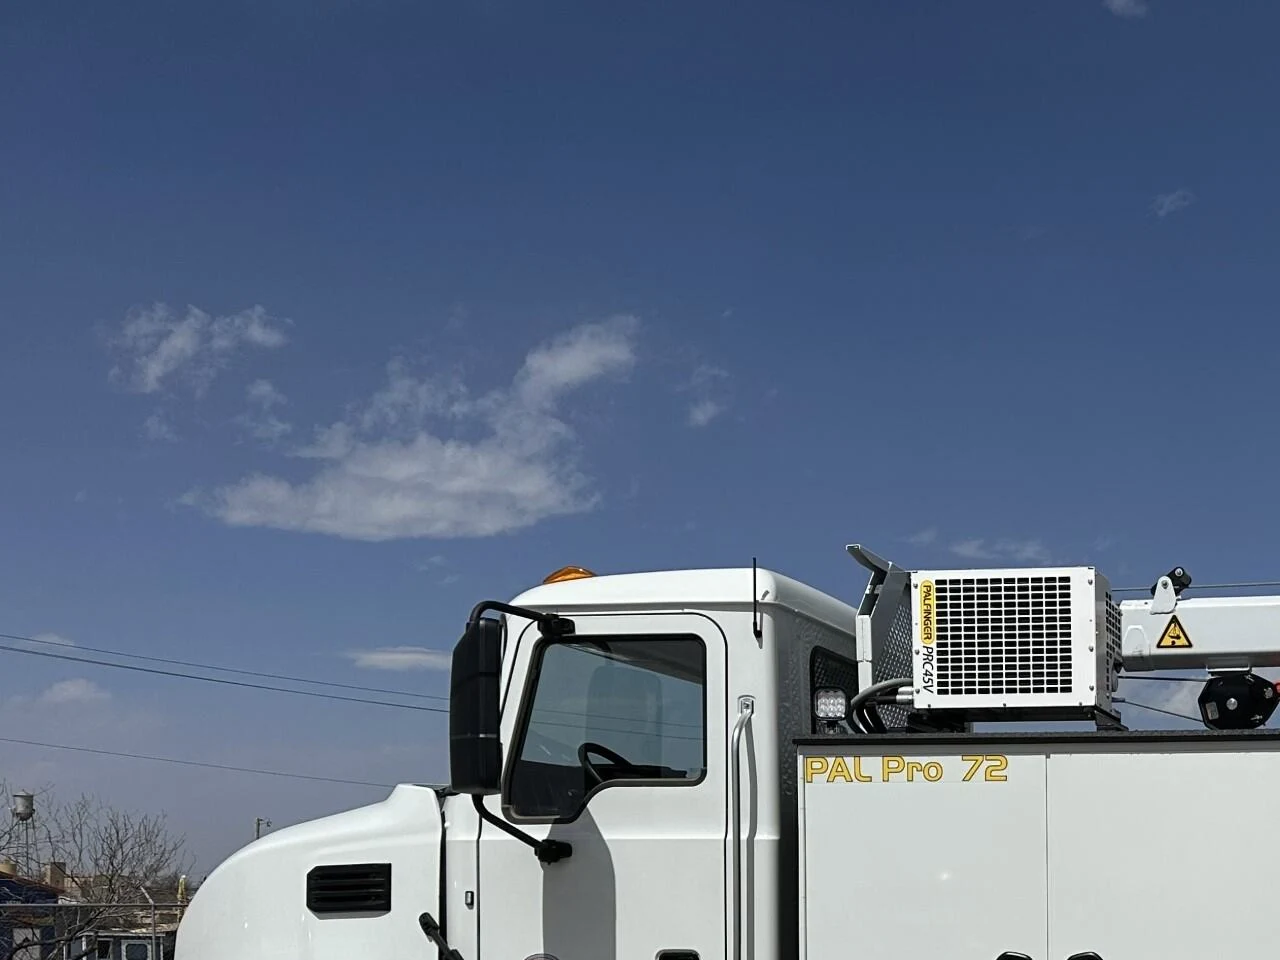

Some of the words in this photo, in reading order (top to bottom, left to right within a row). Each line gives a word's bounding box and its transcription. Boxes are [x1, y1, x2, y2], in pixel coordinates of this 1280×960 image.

[922, 585, 933, 640] PALFINGER
[922, 645, 934, 694] PRC45V
[805, 755, 873, 784] PAL
[881, 754, 944, 783] Pro
[961, 754, 1009, 783] 72
